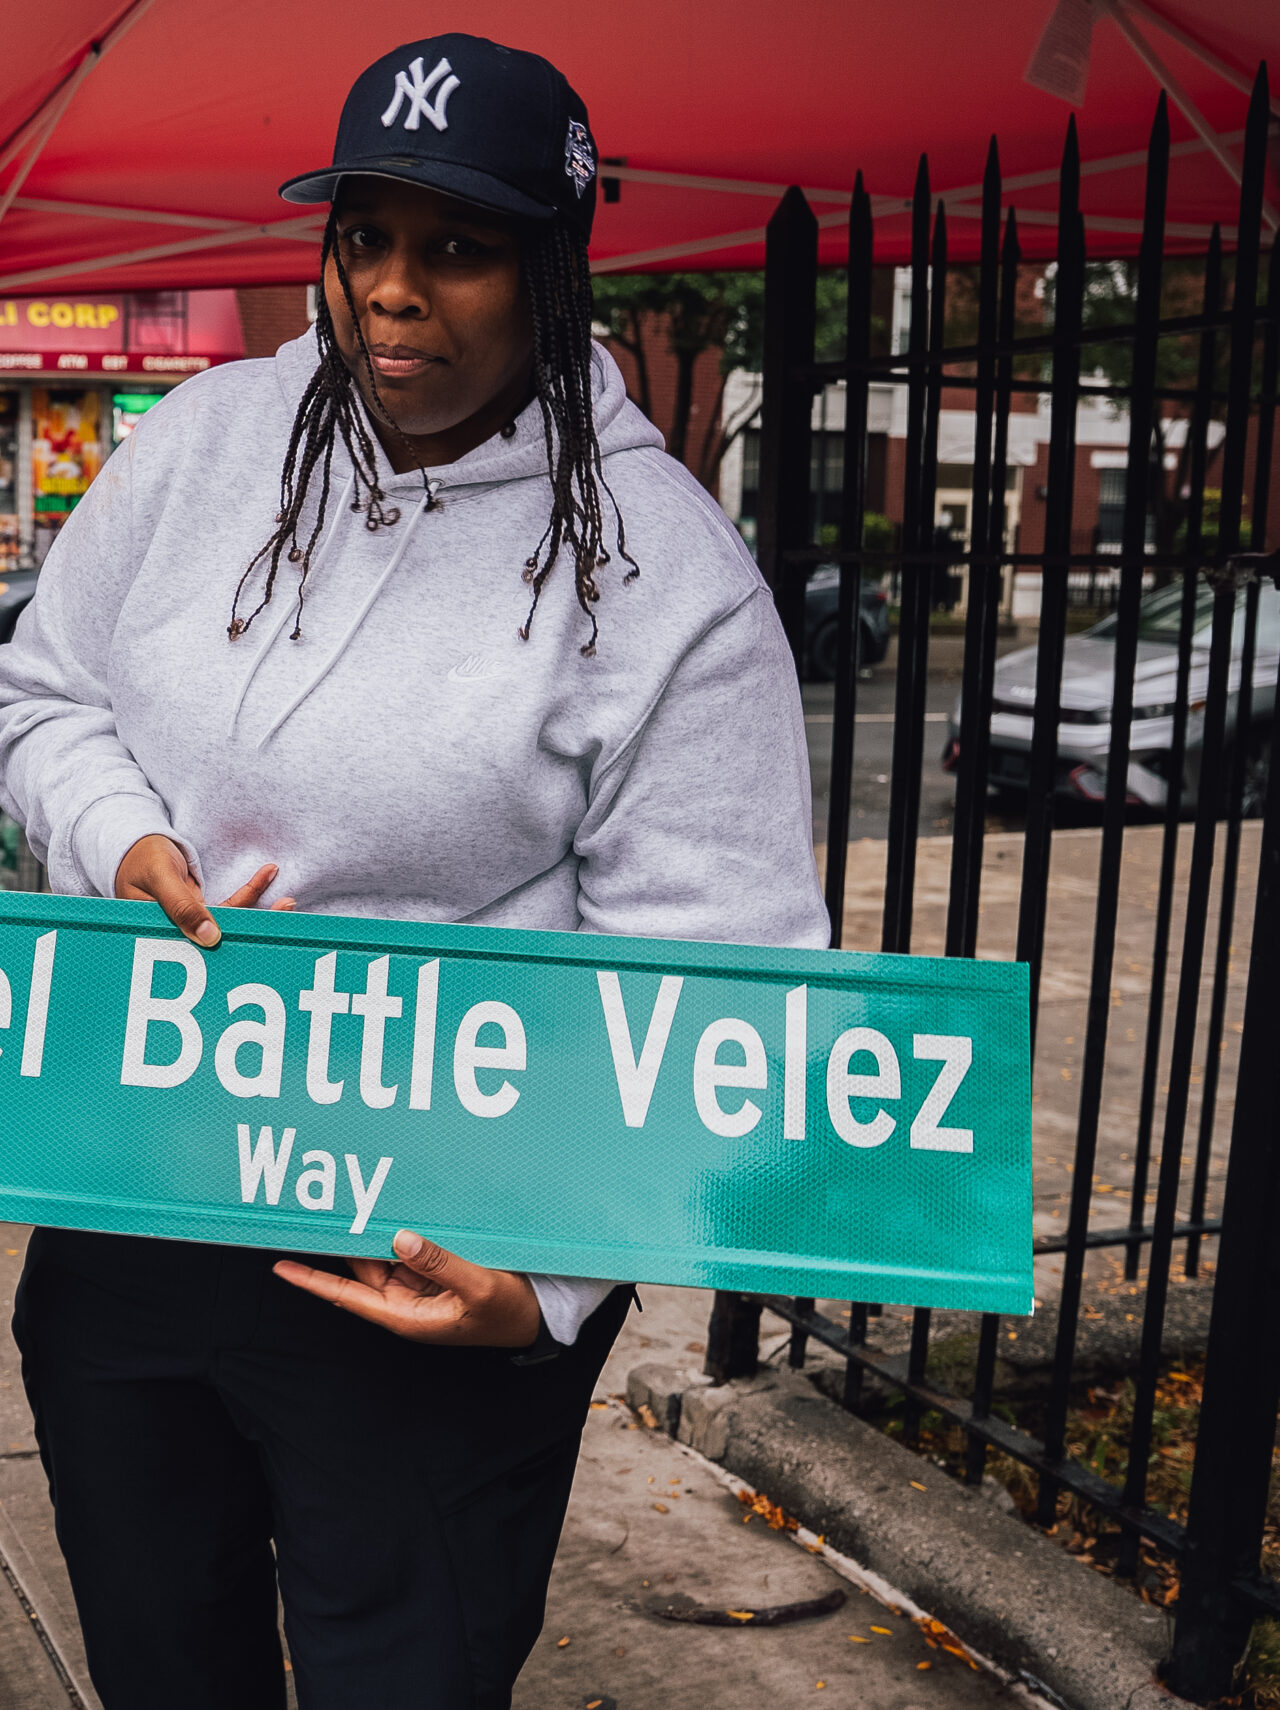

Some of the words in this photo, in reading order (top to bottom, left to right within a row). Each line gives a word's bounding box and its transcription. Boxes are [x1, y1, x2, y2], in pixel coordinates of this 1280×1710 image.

[381, 57, 461, 131] NY
[27, 303, 118, 328] CORP
[57, 354, 89, 369] ATM
[120, 937, 527, 1119] Battle
[596, 970, 974, 1154] Velez
[237, 1123, 394, 1235] Way
